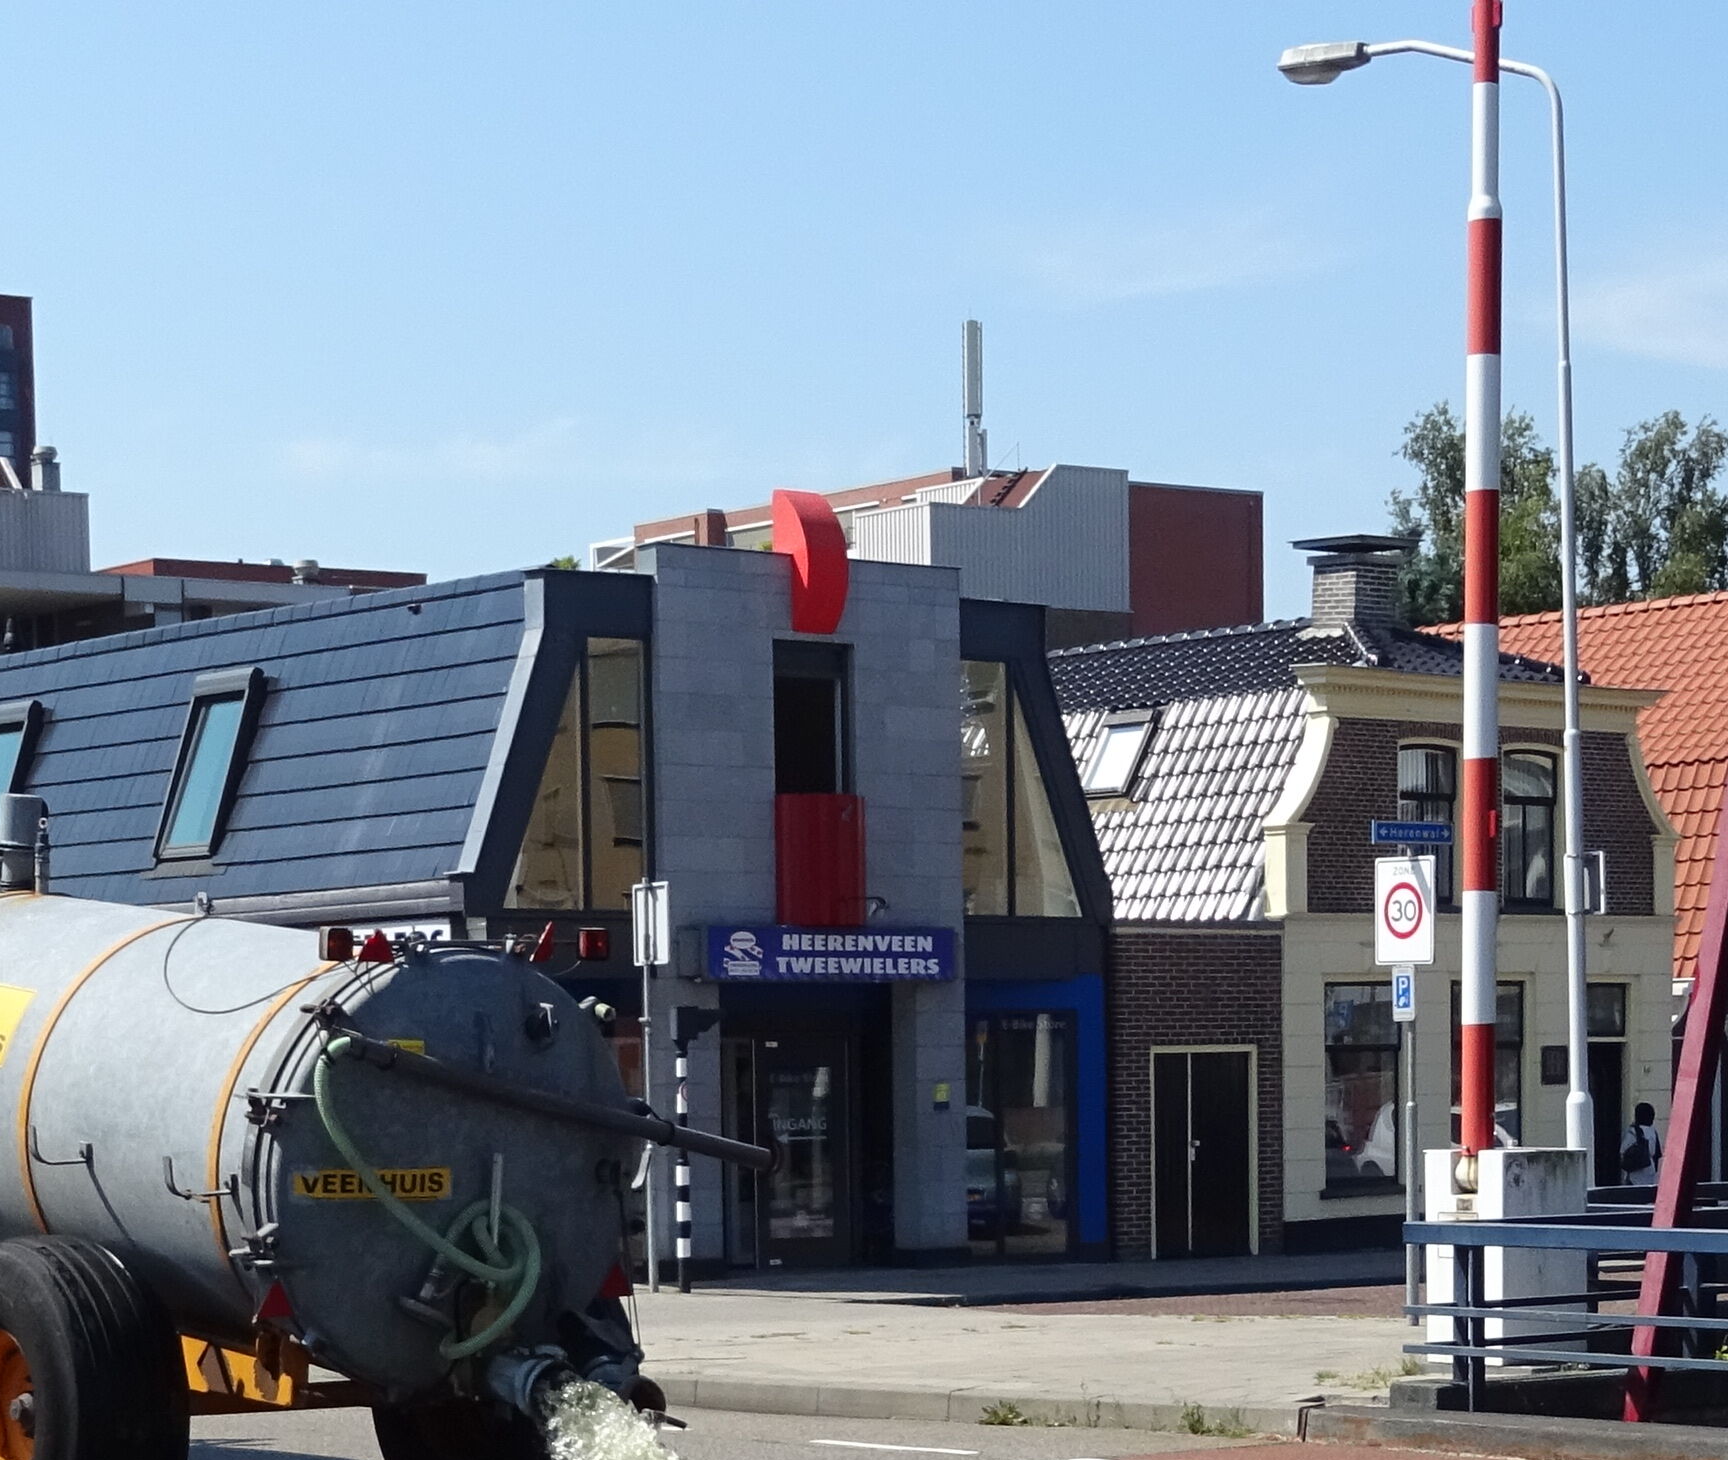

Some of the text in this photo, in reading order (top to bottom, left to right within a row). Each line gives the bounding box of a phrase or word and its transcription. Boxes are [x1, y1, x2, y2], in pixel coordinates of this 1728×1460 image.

[1389, 826, 1440, 839] Herenwal
[1391, 900, 1417, 922] 30
[782, 934, 933, 952] HEERENVEEN
[776, 957, 940, 975] TWEEWIELERS
[1399, 977, 1408, 995] P
